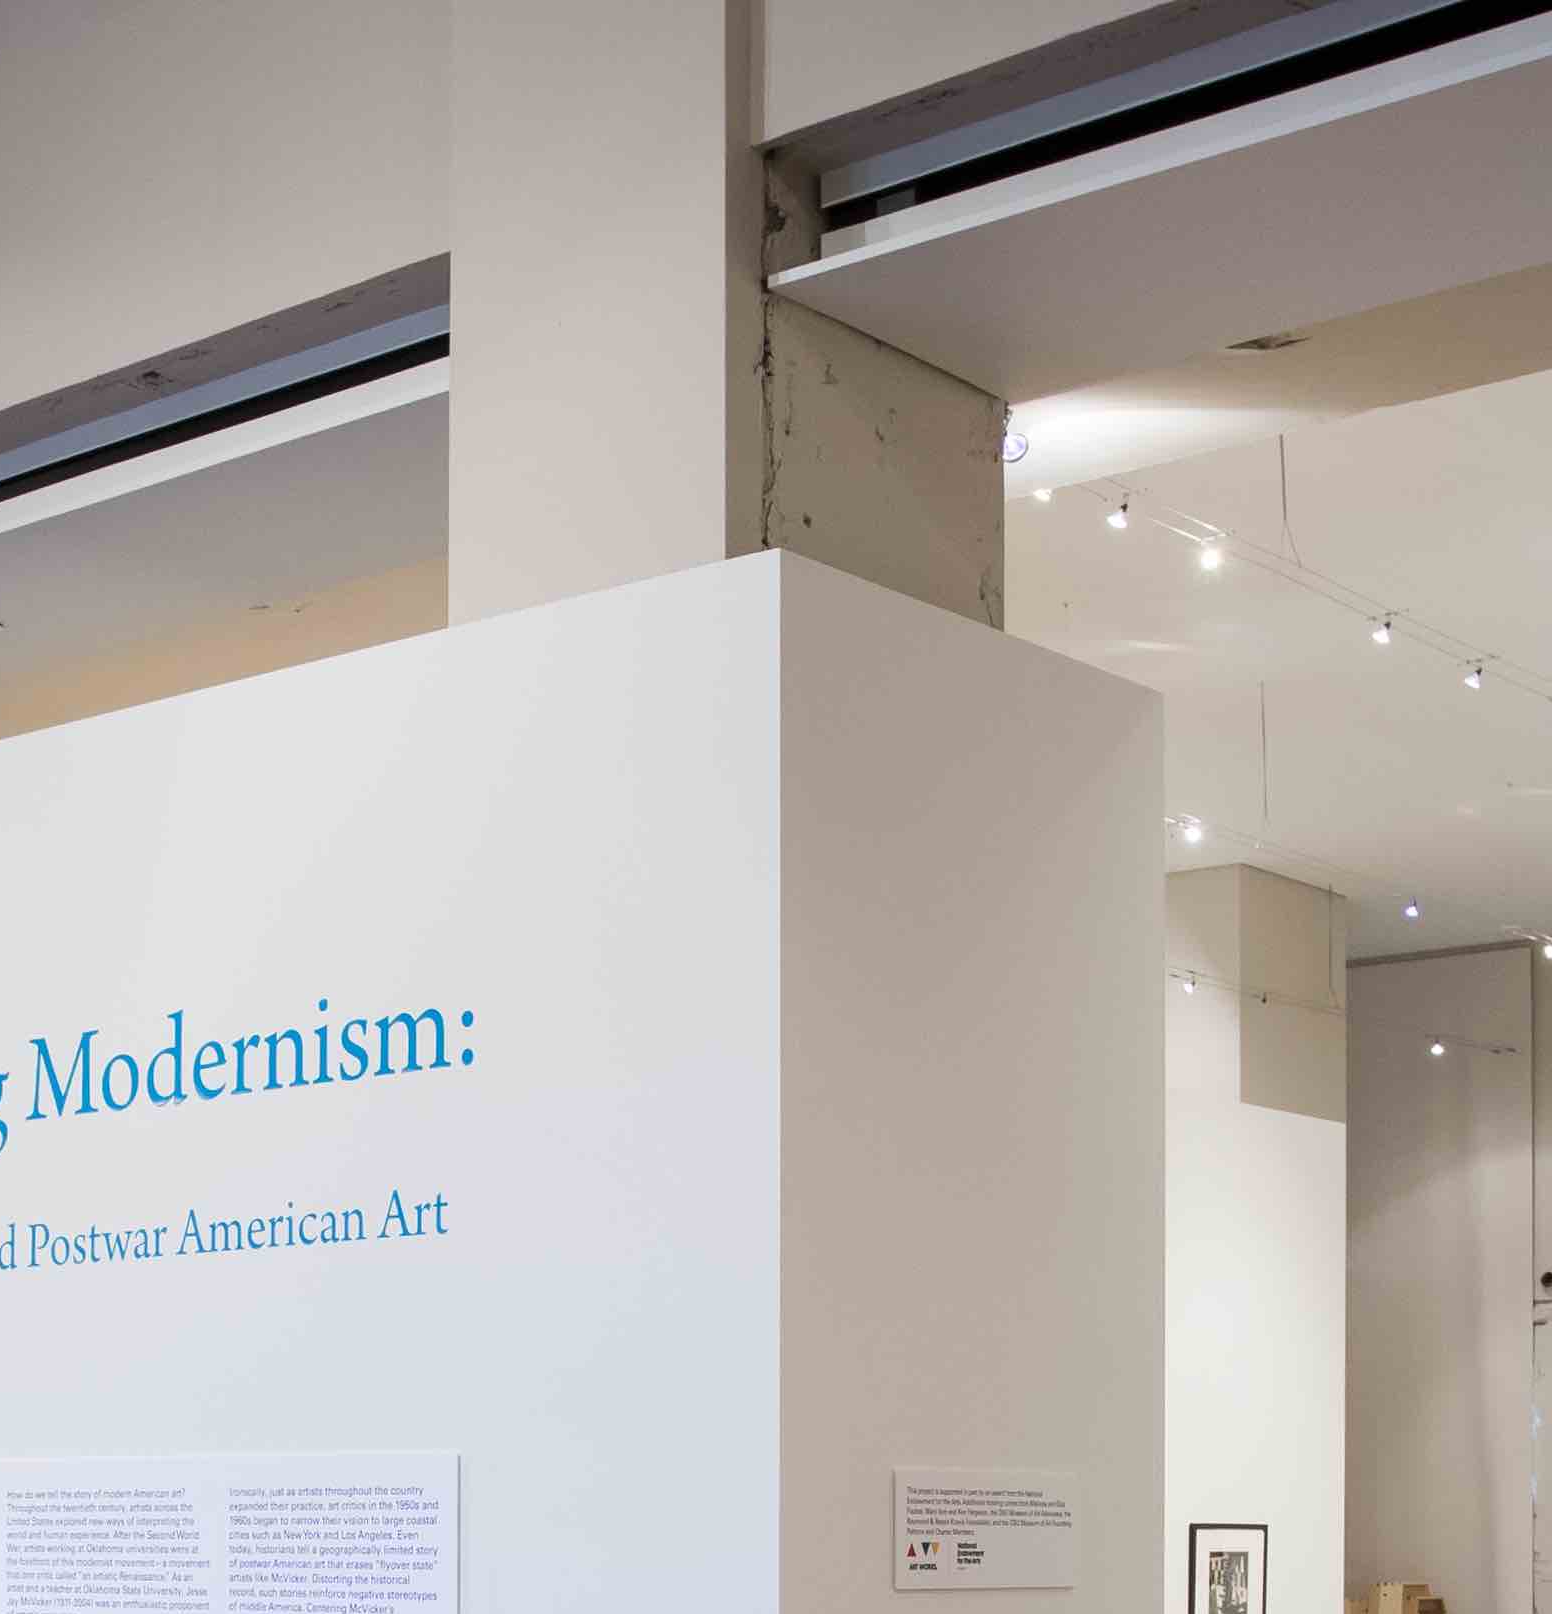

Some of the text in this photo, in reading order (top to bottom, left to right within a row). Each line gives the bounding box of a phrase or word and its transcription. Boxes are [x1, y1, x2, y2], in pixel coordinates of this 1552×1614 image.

[24, 995, 477, 1121] Modernism:
[26, 1222, 169, 1272] Postwar
[175, 1201, 368, 1257] American
[378, 1187, 450, 1239] Art
[325, 1486, 372, 1499] throughout
[374, 1486, 389, 1496] the
[422, 1500, 439, 1510] and
[272, 1559, 313, 1569] American
[354, 1574, 369, 1584] the
